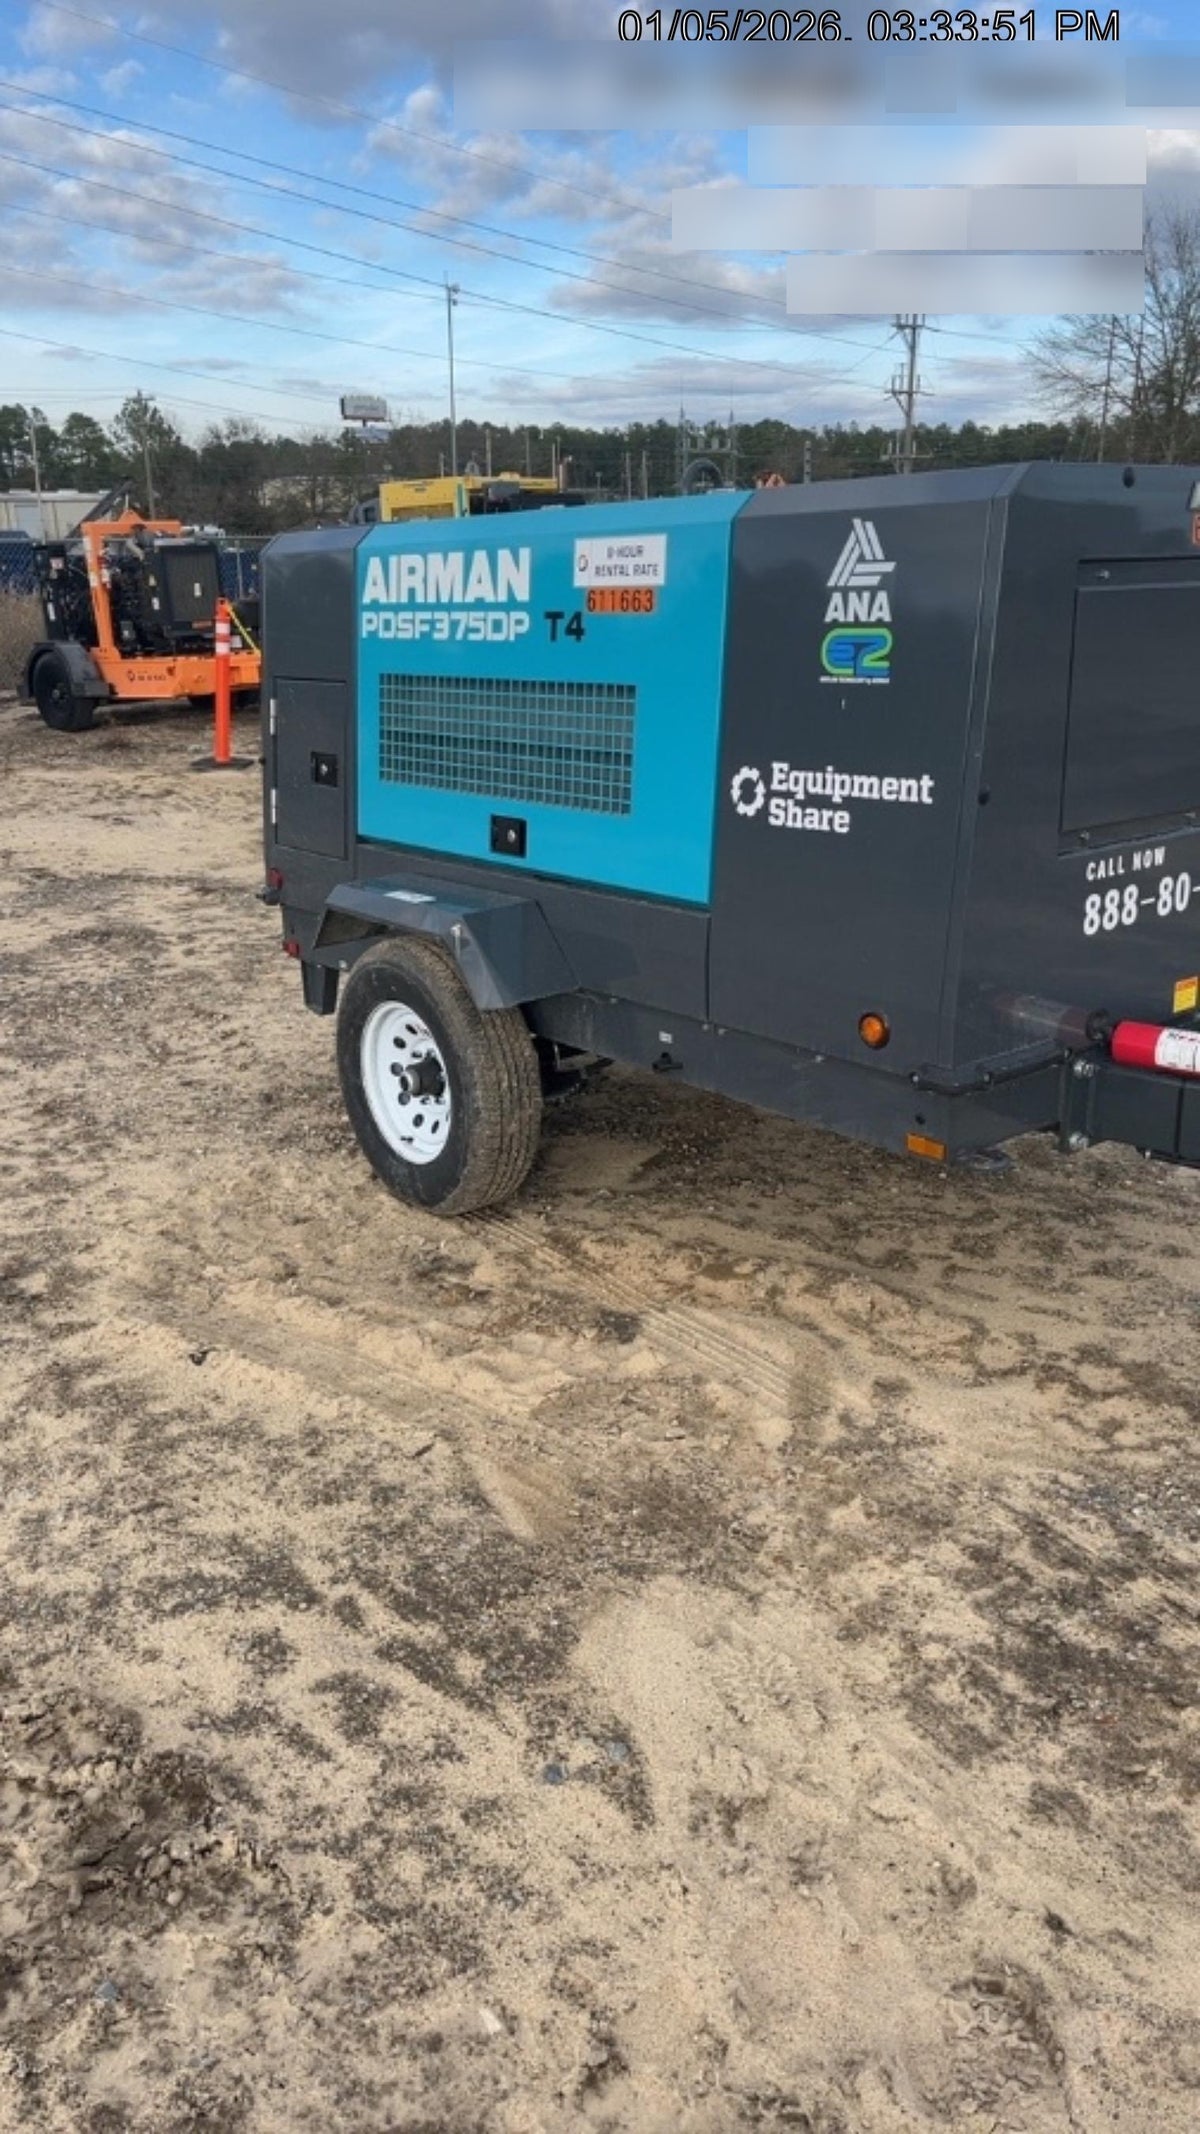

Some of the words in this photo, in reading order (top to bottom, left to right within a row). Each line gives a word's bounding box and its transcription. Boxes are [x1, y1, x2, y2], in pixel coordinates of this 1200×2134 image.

[363, 547, 530, 603] AIRMAN
[595, 565, 631, 577] RENTAL
[633, 563, 658, 577] RATE
[587, 589, 653, 613] 611663
[825, 591, 892, 622] ANA
[544, 611, 585, 641] T4
[770, 761, 934, 804] Equipment
[768, 797, 850, 834] Share
[1086, 855, 1125, 881] CALL
[1132, 846, 1166, 871] NOW
